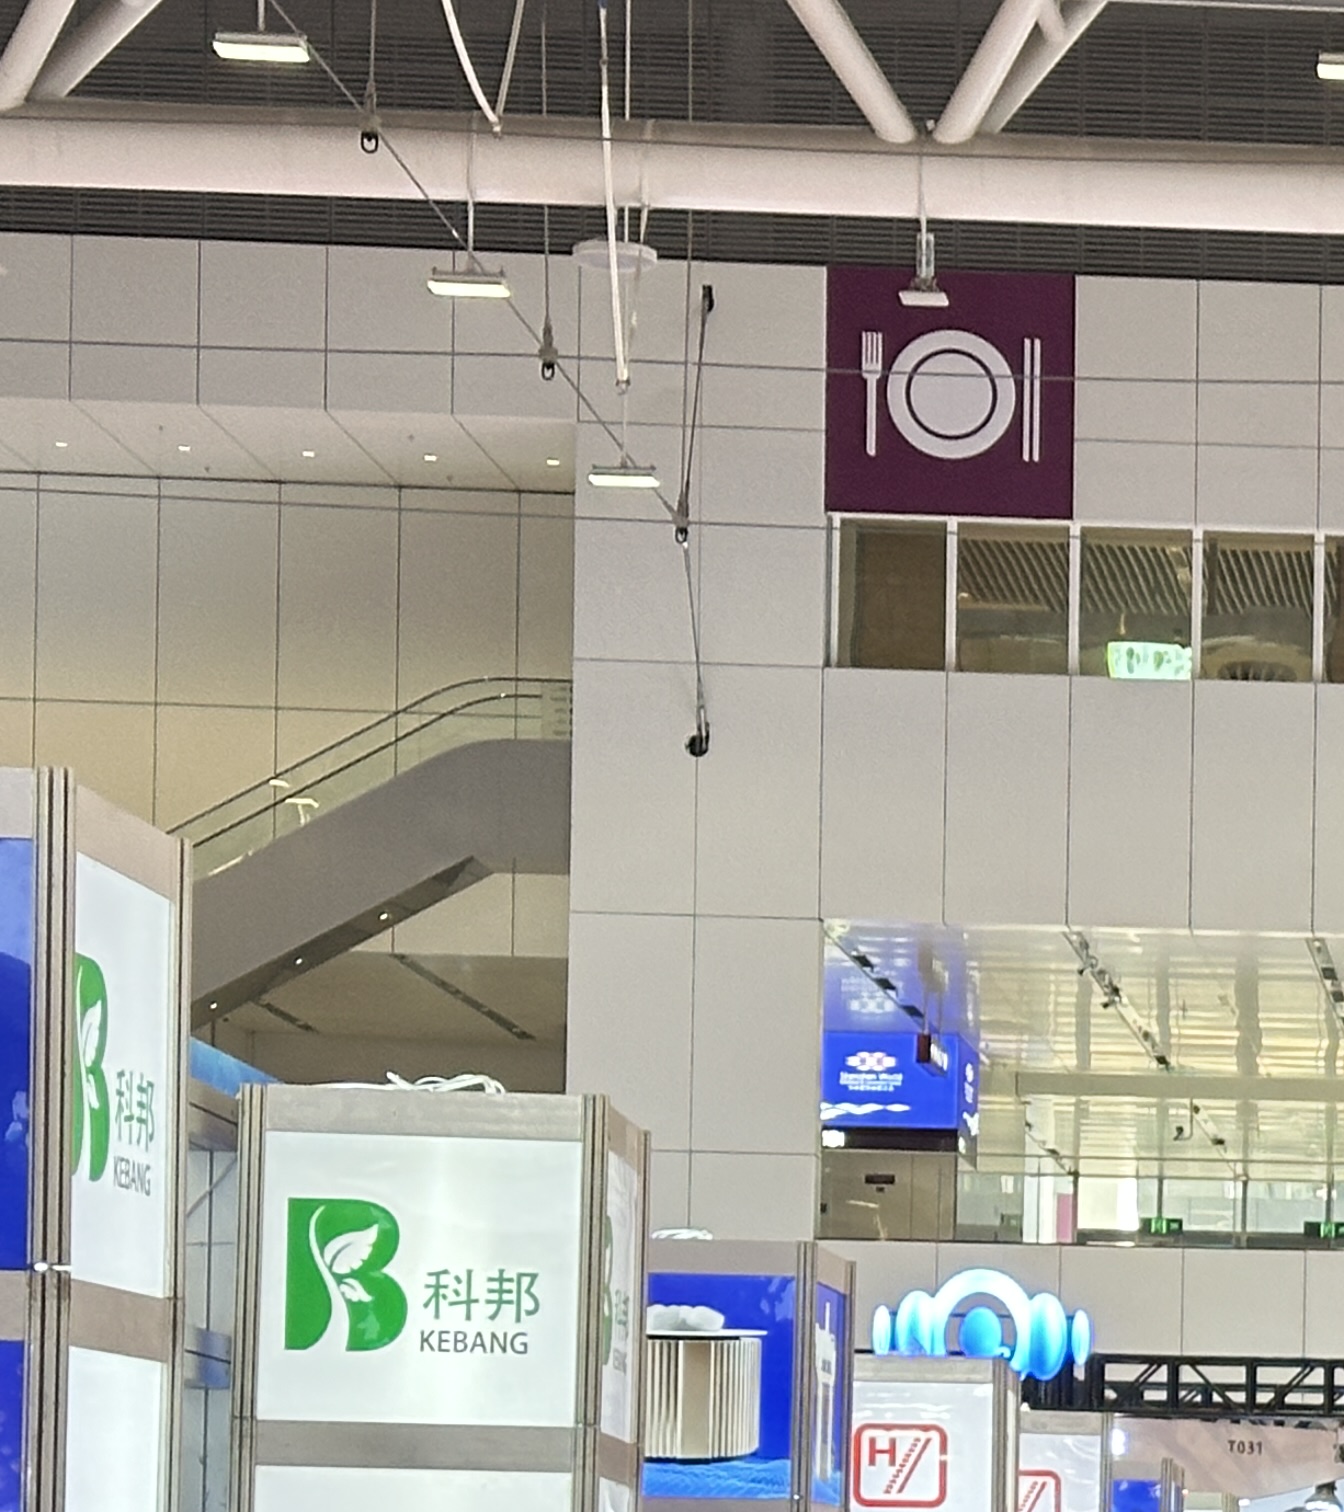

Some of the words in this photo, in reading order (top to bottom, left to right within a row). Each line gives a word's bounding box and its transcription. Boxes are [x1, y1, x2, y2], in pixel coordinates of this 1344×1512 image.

[115, 1068, 155, 1152] 科邦
[113, 1155, 151, 1198] KEBANG
[424, 1267, 540, 1324] 科邦
[419, 1329, 529, 1355] KEBANG
[1227, 1439, 1263, 1455] T031
